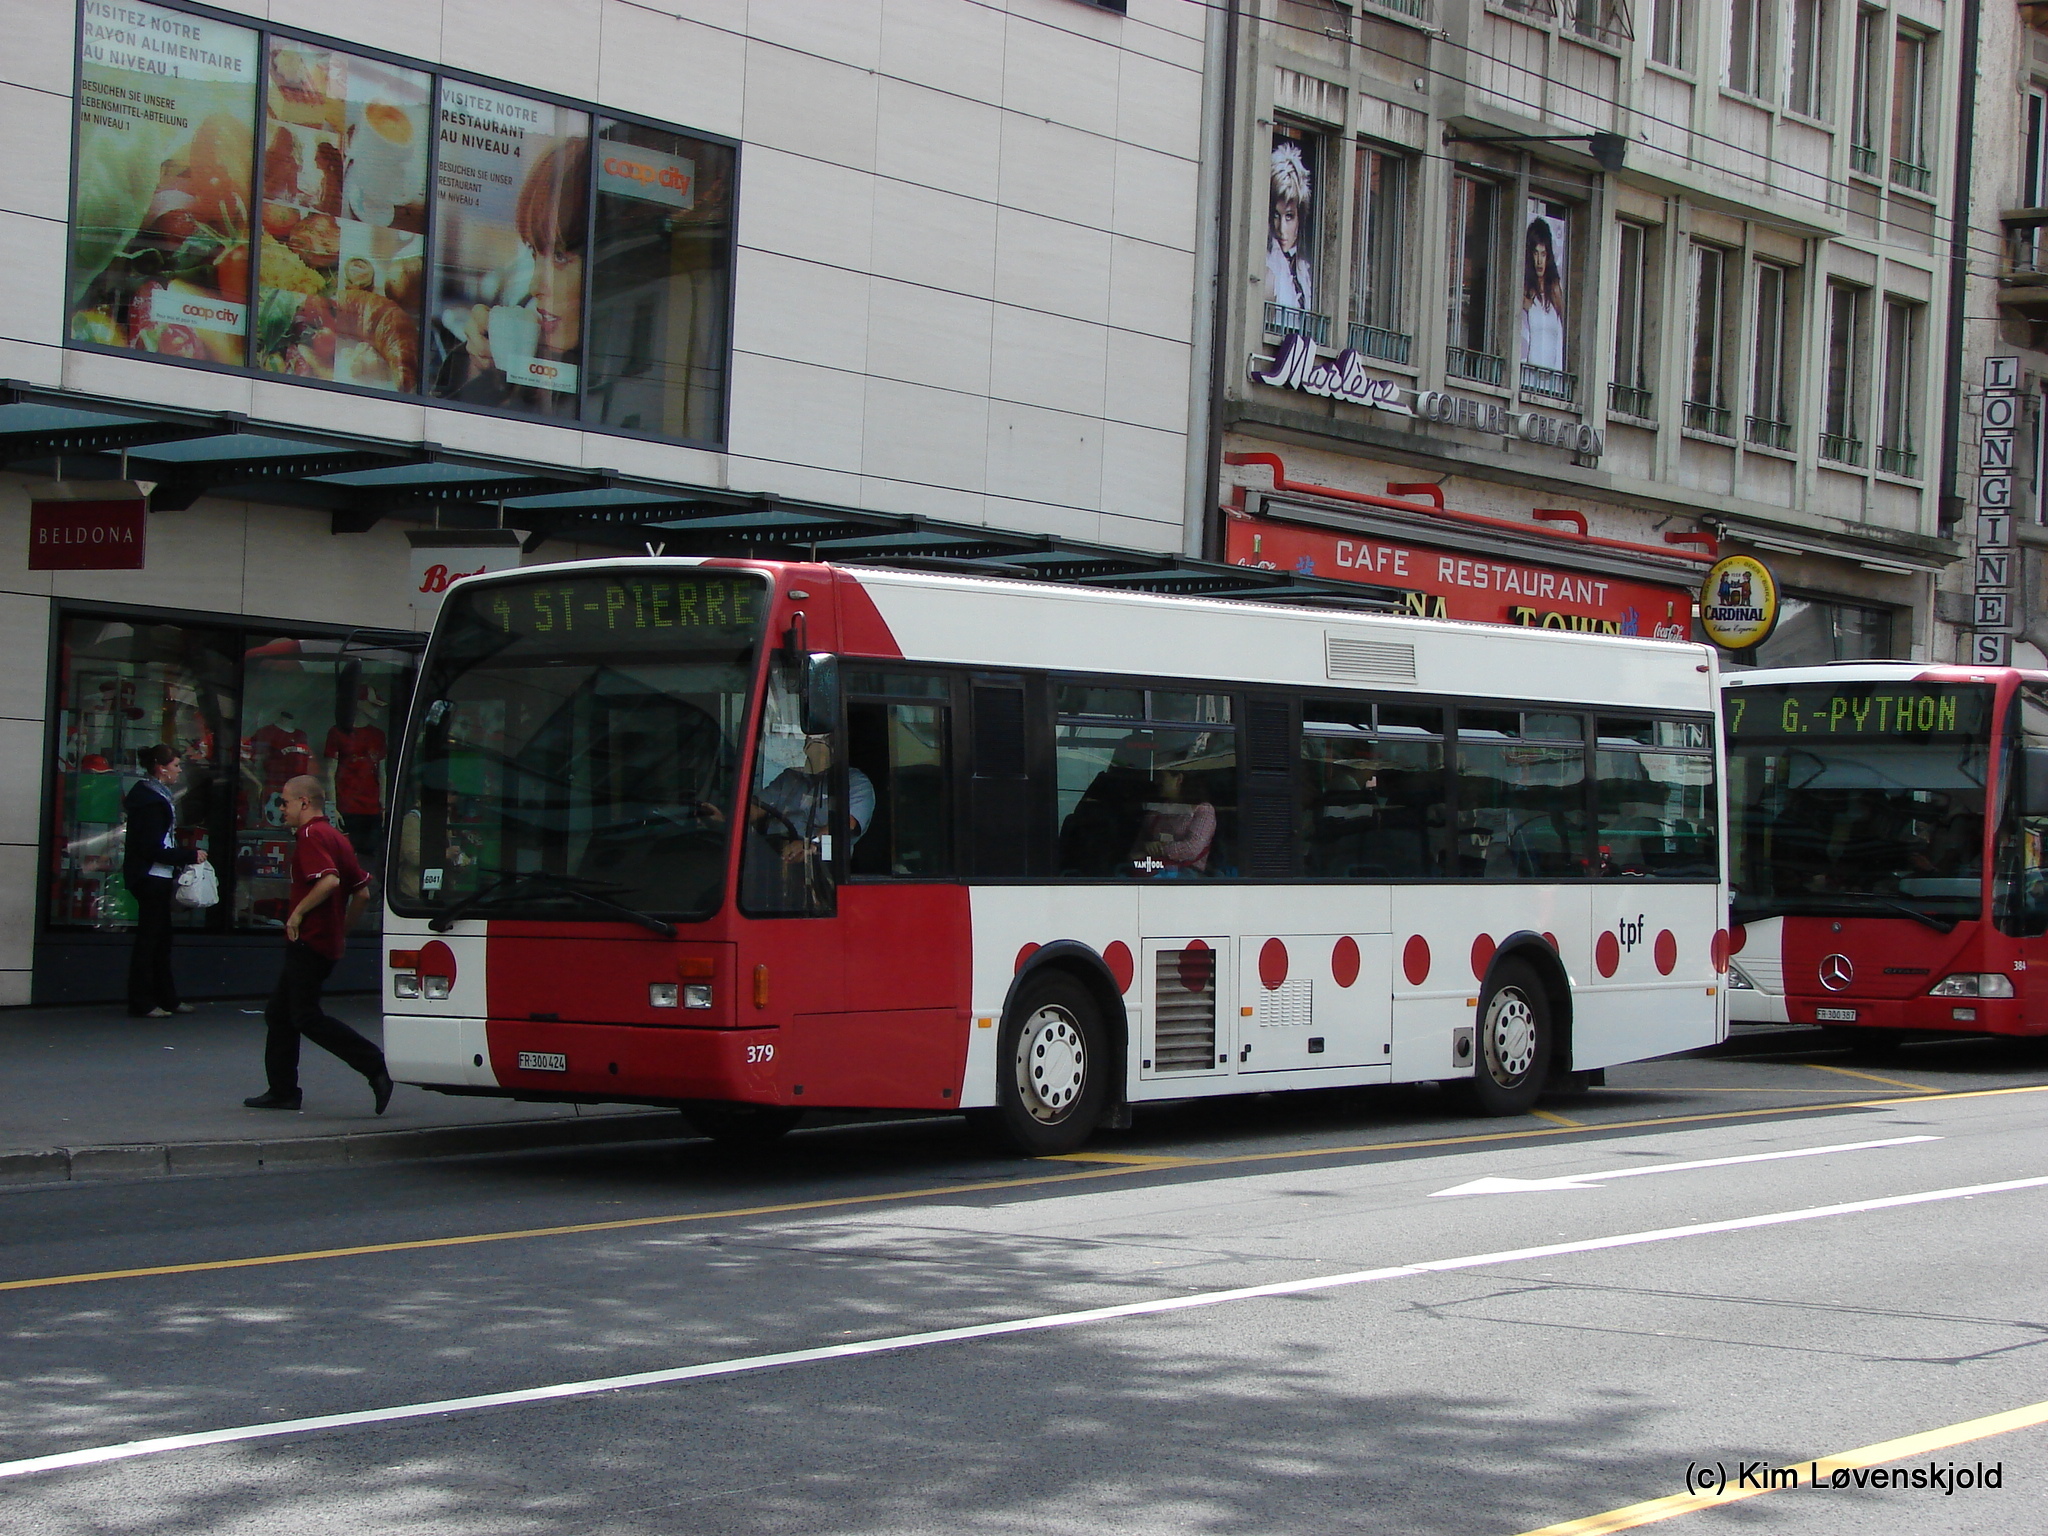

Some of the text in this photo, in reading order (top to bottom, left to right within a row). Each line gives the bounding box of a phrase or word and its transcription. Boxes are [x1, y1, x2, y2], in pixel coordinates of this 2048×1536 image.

[85, 1, 201, 41] VISITEZ NOTRE
[84, 45, 179, 78] AU NIVEAU 1
[85, 22, 242, 72] RAYON ALIMENTAIRE
[82, 80, 176, 110] BESUCHEN SIE UNSERE
[443, 89, 538, 123] VISITEZ NOTRE
[81, 96, 188, 128] LEBENSMITTEL-ABTEILUNG
[81, 112, 91, 122] IM
[94, 114, 123, 129] NIVEAU
[442, 109, 525, 139] RESTAURANT
[440, 129, 520, 158] AU NIVEAU 4
[438, 176, 482, 193] RESTAURANT
[439, 161, 513, 185] BESUCHEN SIE UNSER
[604, 157, 691, 196] coop city
[437, 190, 446, 199] IM
[449, 192, 473, 206] NIVEAU
[183, 304, 238, 325] coop city
[529, 364, 558, 379] coop
[1418, 391, 1605, 456] COIFFURE CREATION
[1978, 360, 2013, 664] LONGINES
[39, 527, 133, 544] BELDONA
[1336, 540, 1410, 577] CAFE
[1438, 557, 1608, 606] RESTAURANT
[493, 581, 755, 632] 4 ST-PIERRE
[1704, 605, 1766, 621] CARDINAL
[1731, 696, 1956, 733] 7 G.-PYTHON
[1619, 913, 1644, 953] tpf
[2013, 961, 2026, 971] 384
[747, 1044, 774, 1063] 379
